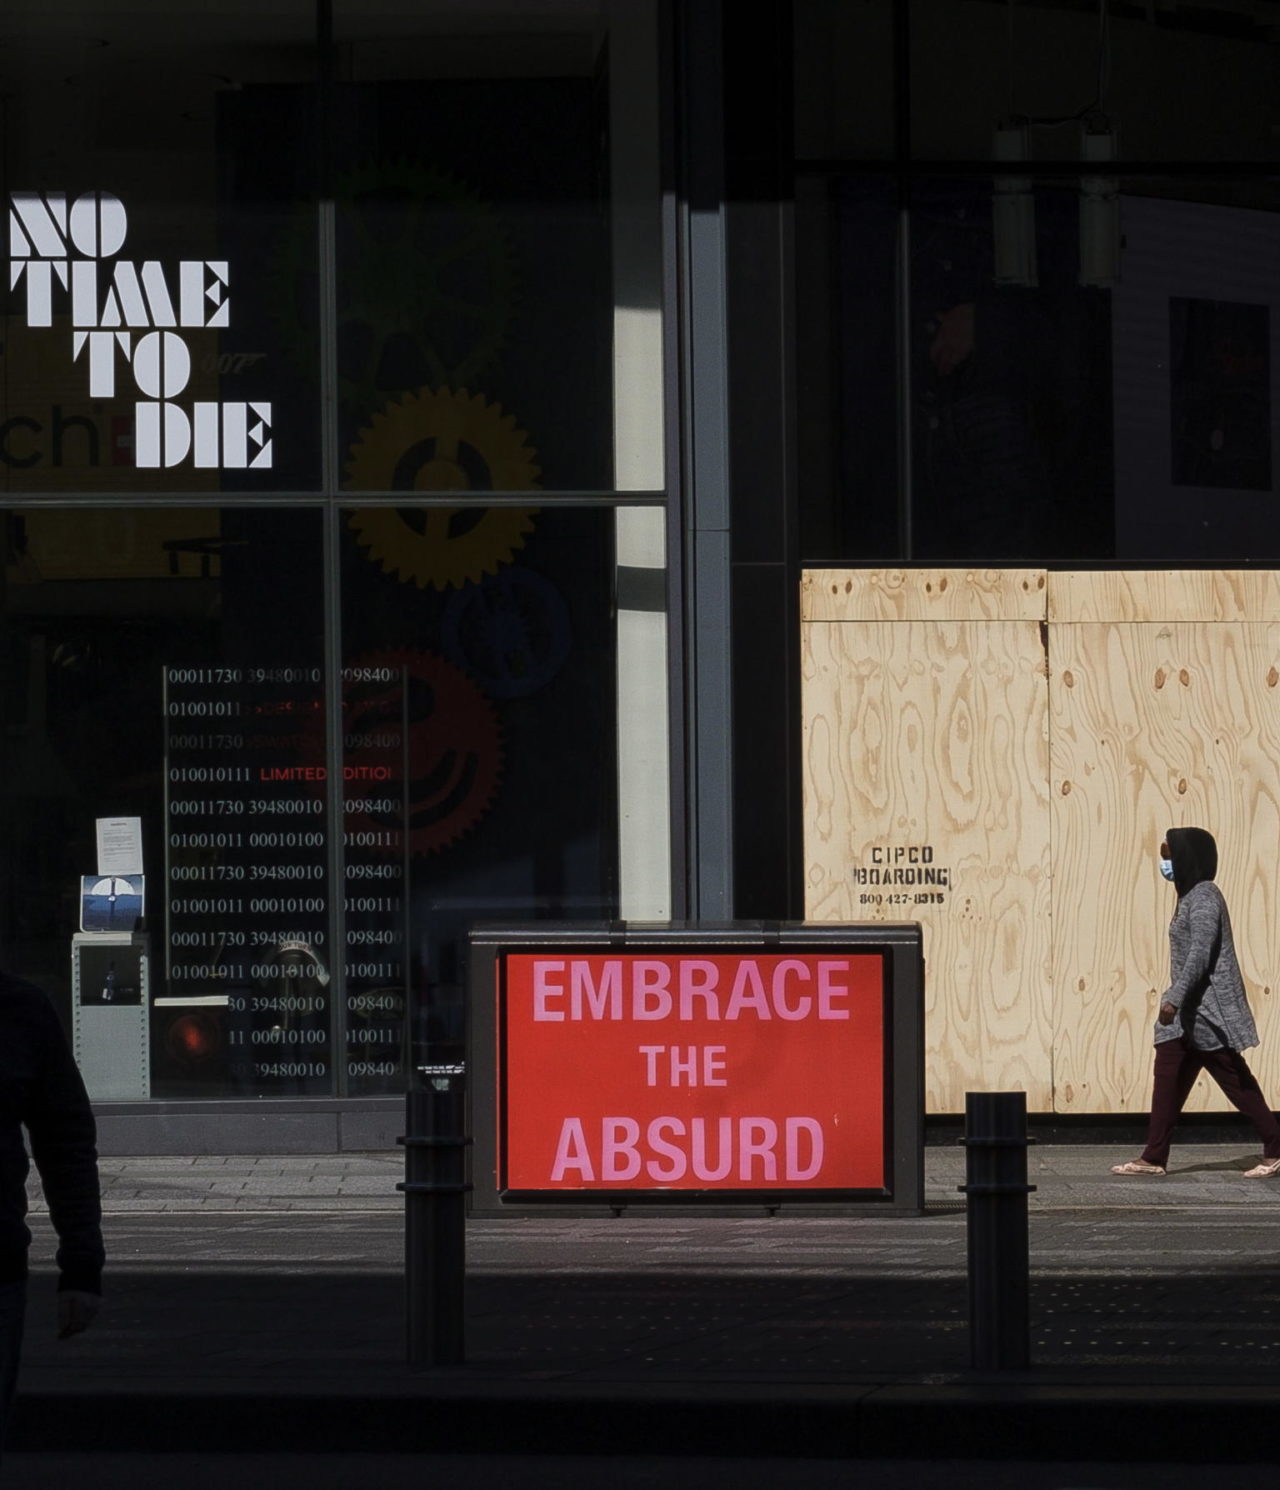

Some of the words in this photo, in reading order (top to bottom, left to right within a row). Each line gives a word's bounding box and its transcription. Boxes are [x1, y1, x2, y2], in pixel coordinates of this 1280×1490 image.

[10, 191, 127, 258] NO
[10, 261, 230, 327] TIME
[73, 331, 190, 399] TO
[135, 402, 273, 468] DIE
[169, 669, 242, 683] 00011730
[169, 734, 243, 749] 00011730
[344, 734, 400, 748] 098400
[170, 768, 250, 782] 010010111
[260, 768, 328, 781] LIMITED
[170, 801, 243, 815] 00011730
[249, 800, 323, 814] 39480010
[343, 799, 401, 813] 098400
[170, 833, 242, 847] 01001011
[250, 833, 323, 847] 00010100
[872, 846, 933, 864] CIPCO
[171, 866, 244, 880] 00011730
[249, 866, 323, 880] 39480010
[344, 865, 401, 879] 098400
[857, 867, 948, 886] BOARDING
[171, 899, 242, 913] 01001011
[250, 899, 324, 913] 00010100
[859, 893, 882, 905] 800
[171, 932, 245, 946] 00011730
[250, 932, 324, 945] 39480010
[346, 930, 401, 944] 098400
[533, 960, 849, 1021] EMBRACE
[250, 997, 325, 1011] 39480010
[252, 1030, 326, 1044] 00010100
[639, 1046, 727, 1087] THE
[550, 1117, 824, 1181] ABSURD
